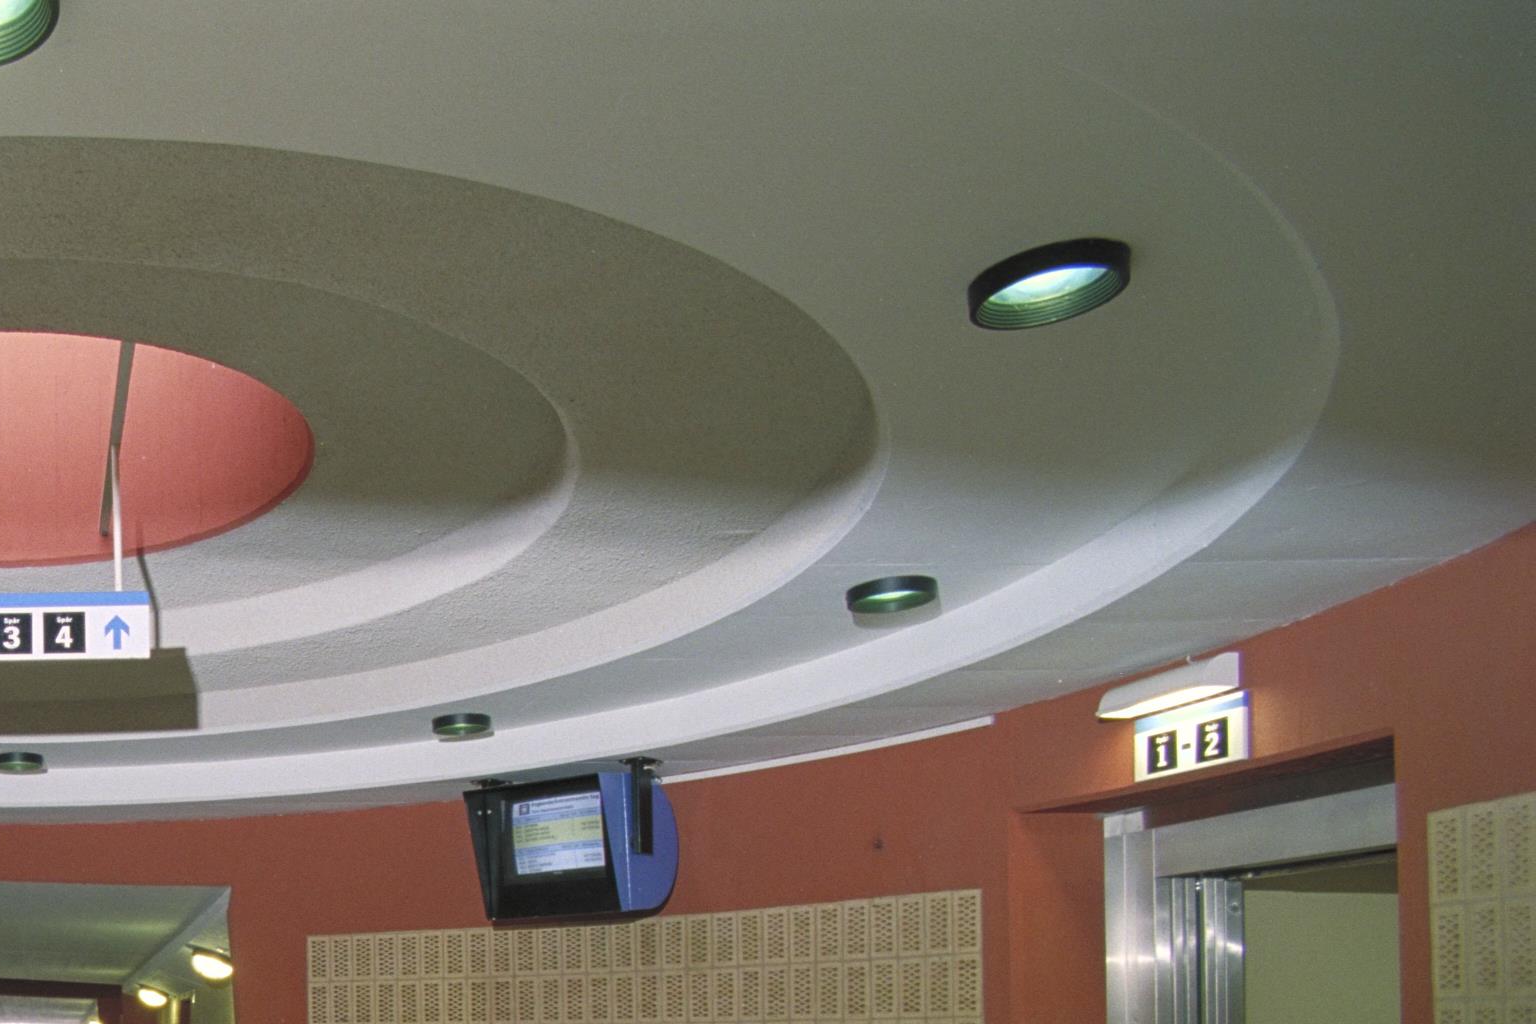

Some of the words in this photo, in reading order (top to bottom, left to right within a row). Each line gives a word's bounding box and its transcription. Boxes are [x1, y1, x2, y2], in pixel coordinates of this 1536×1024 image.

[2, 626, 21, 650] 3
[54, 625, 74, 649] 4
[1156, 744, 1168, 768] 1
[1204, 732, 1219, 757] 2
